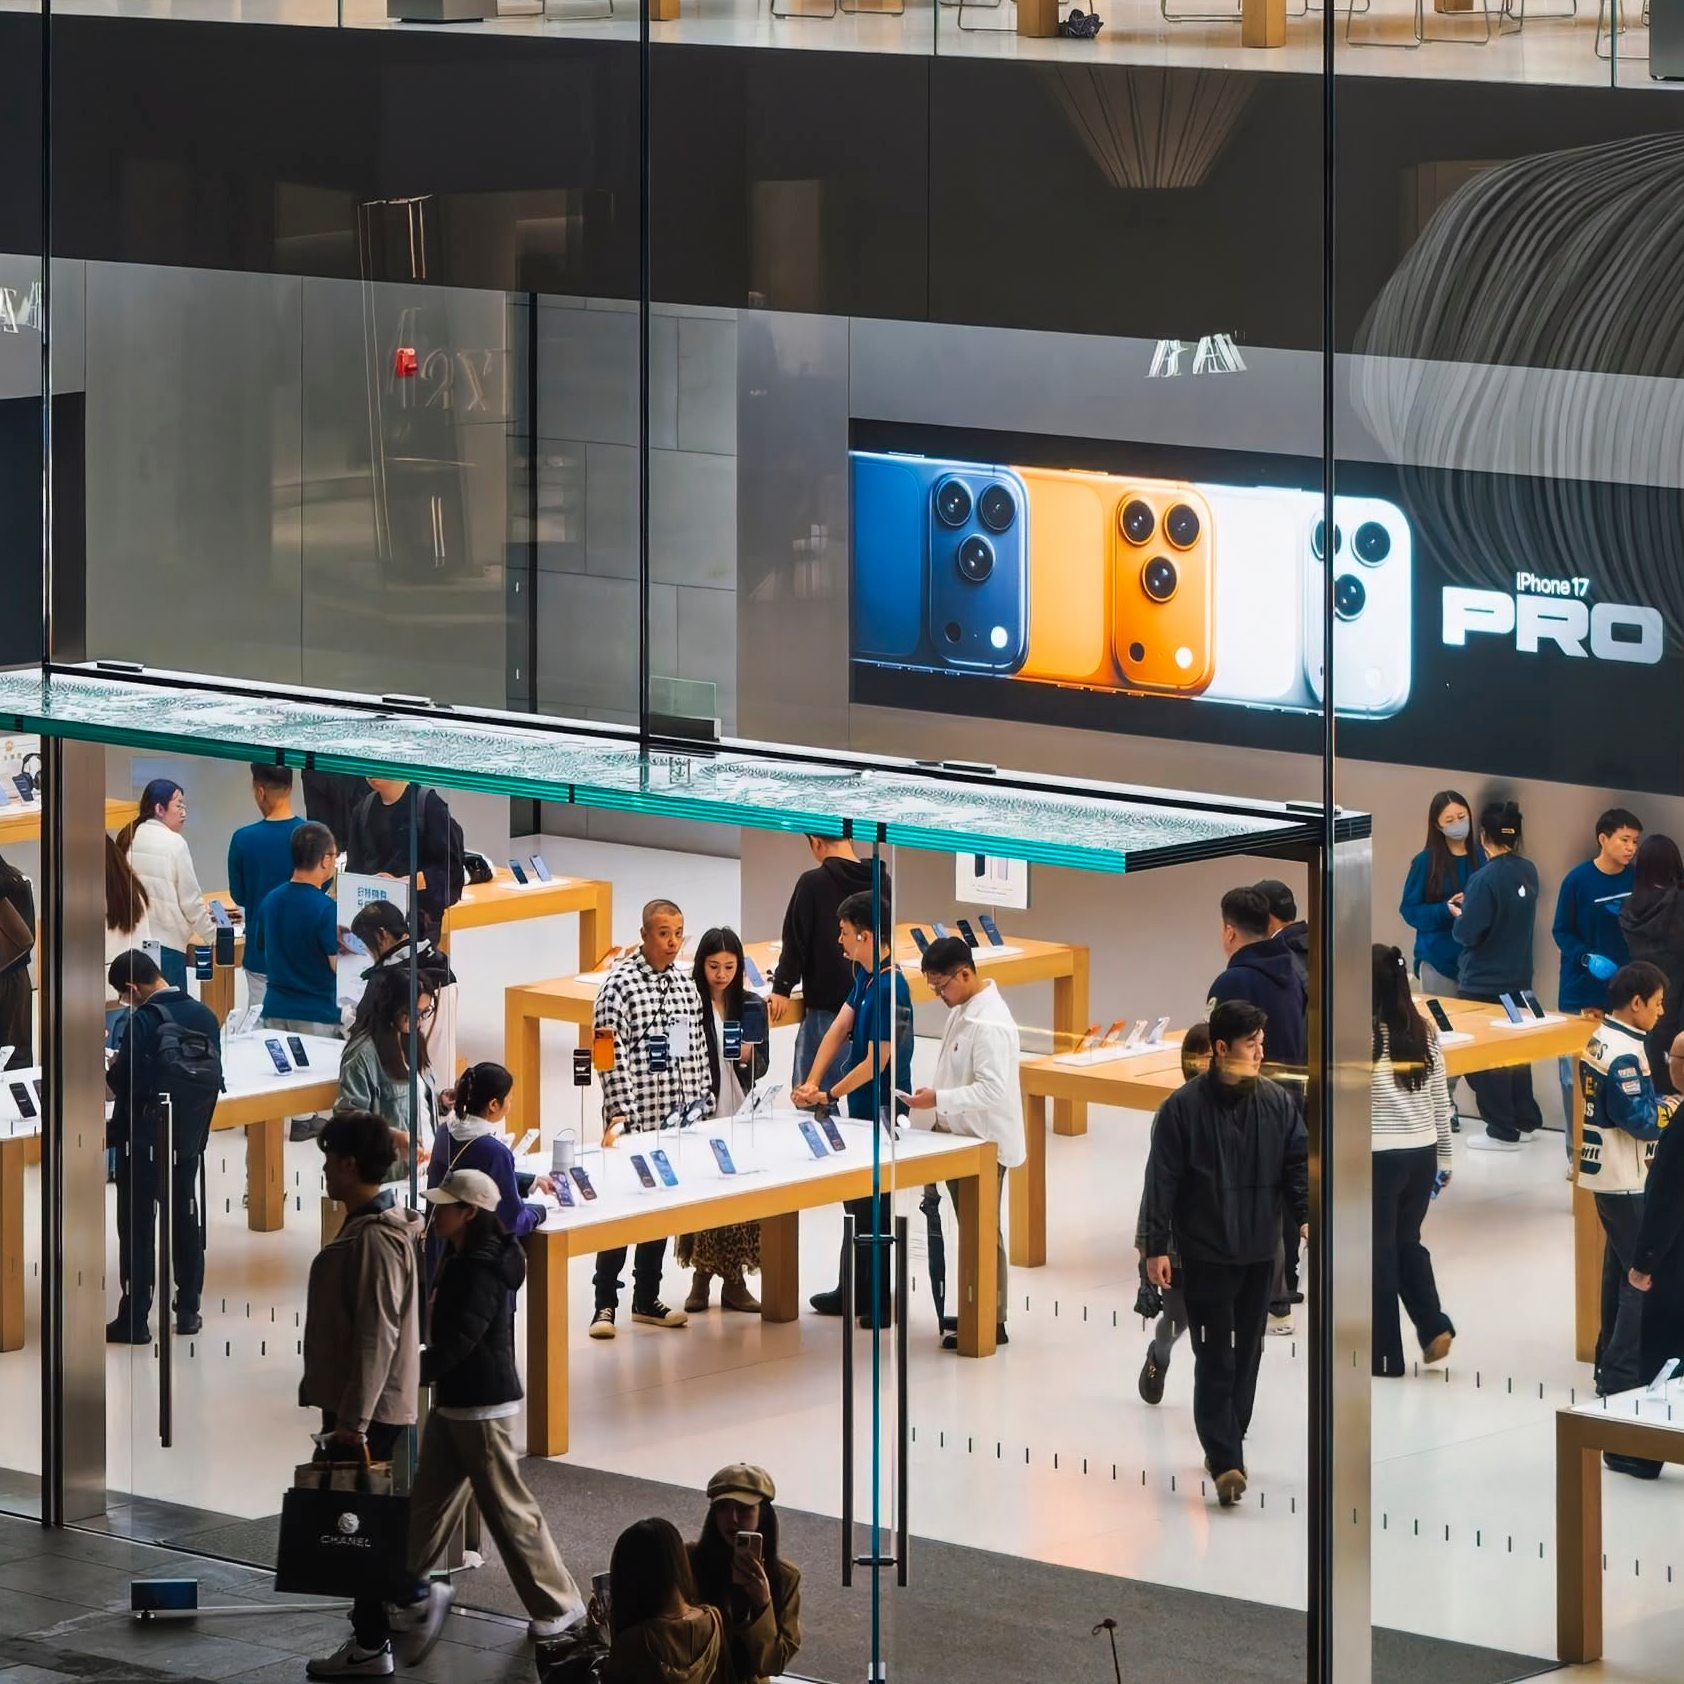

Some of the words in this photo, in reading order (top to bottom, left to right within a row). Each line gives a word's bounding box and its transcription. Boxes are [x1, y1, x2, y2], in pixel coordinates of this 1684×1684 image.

[1516, 571, 1570, 595] iPhone
[1571, 577, 1590, 597] 17
[1442, 586, 1664, 665] PRO
